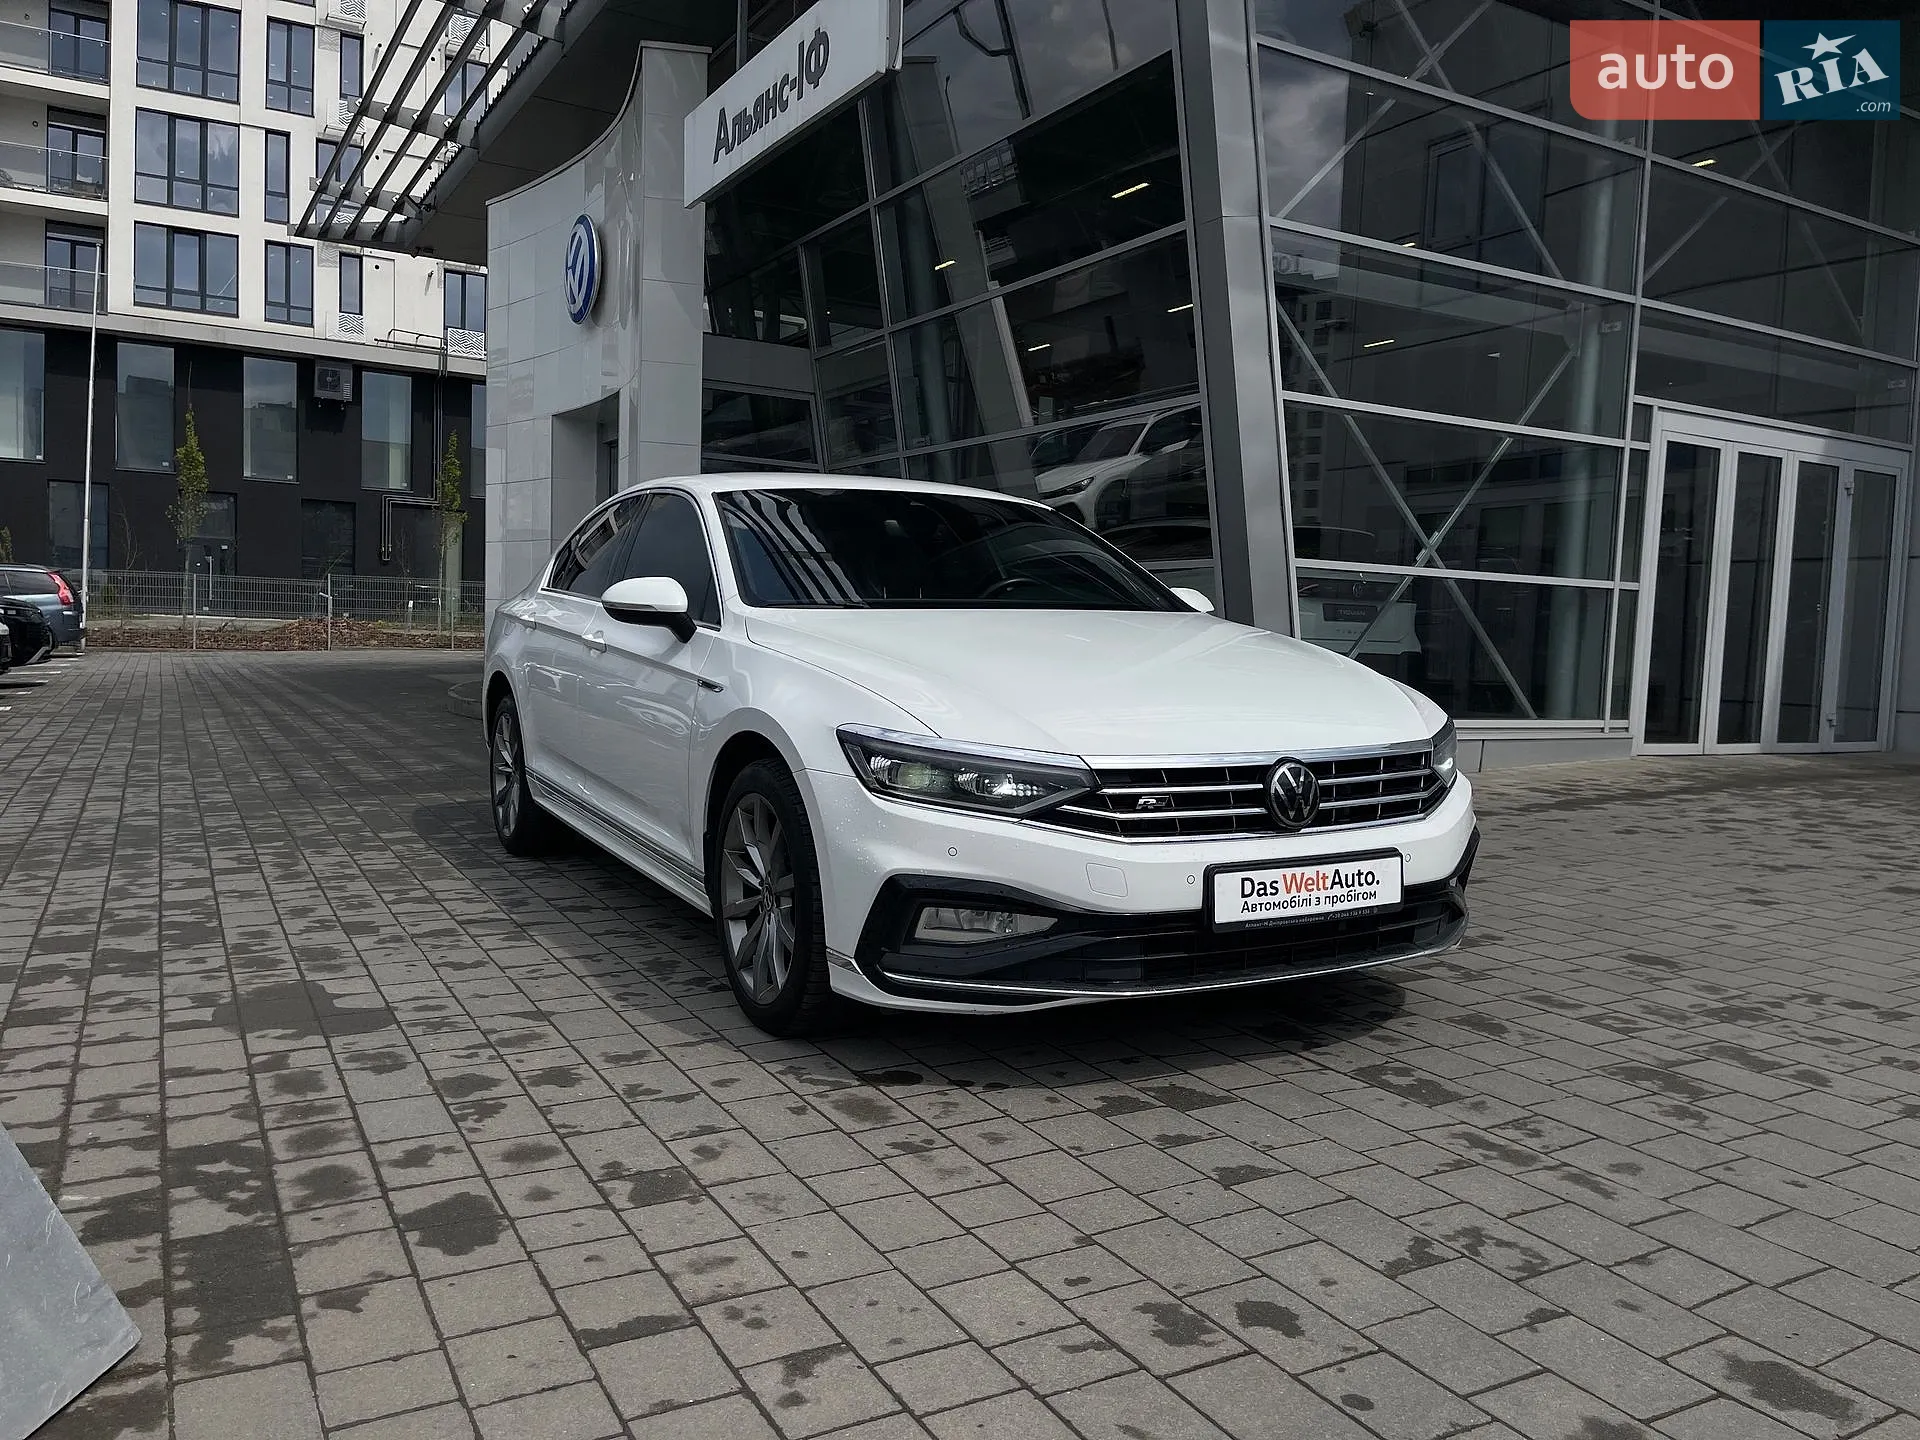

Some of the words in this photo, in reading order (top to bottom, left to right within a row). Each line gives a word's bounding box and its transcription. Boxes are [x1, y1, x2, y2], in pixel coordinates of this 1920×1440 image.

[712, 27, 830, 165] Альянс-ІФ
[1241, 877, 1279, 899] Das
[1241, 894, 1312, 913] Автомобілі
[1314, 896, 1321, 906] з
[1324, 890, 1377, 907] пробігом
